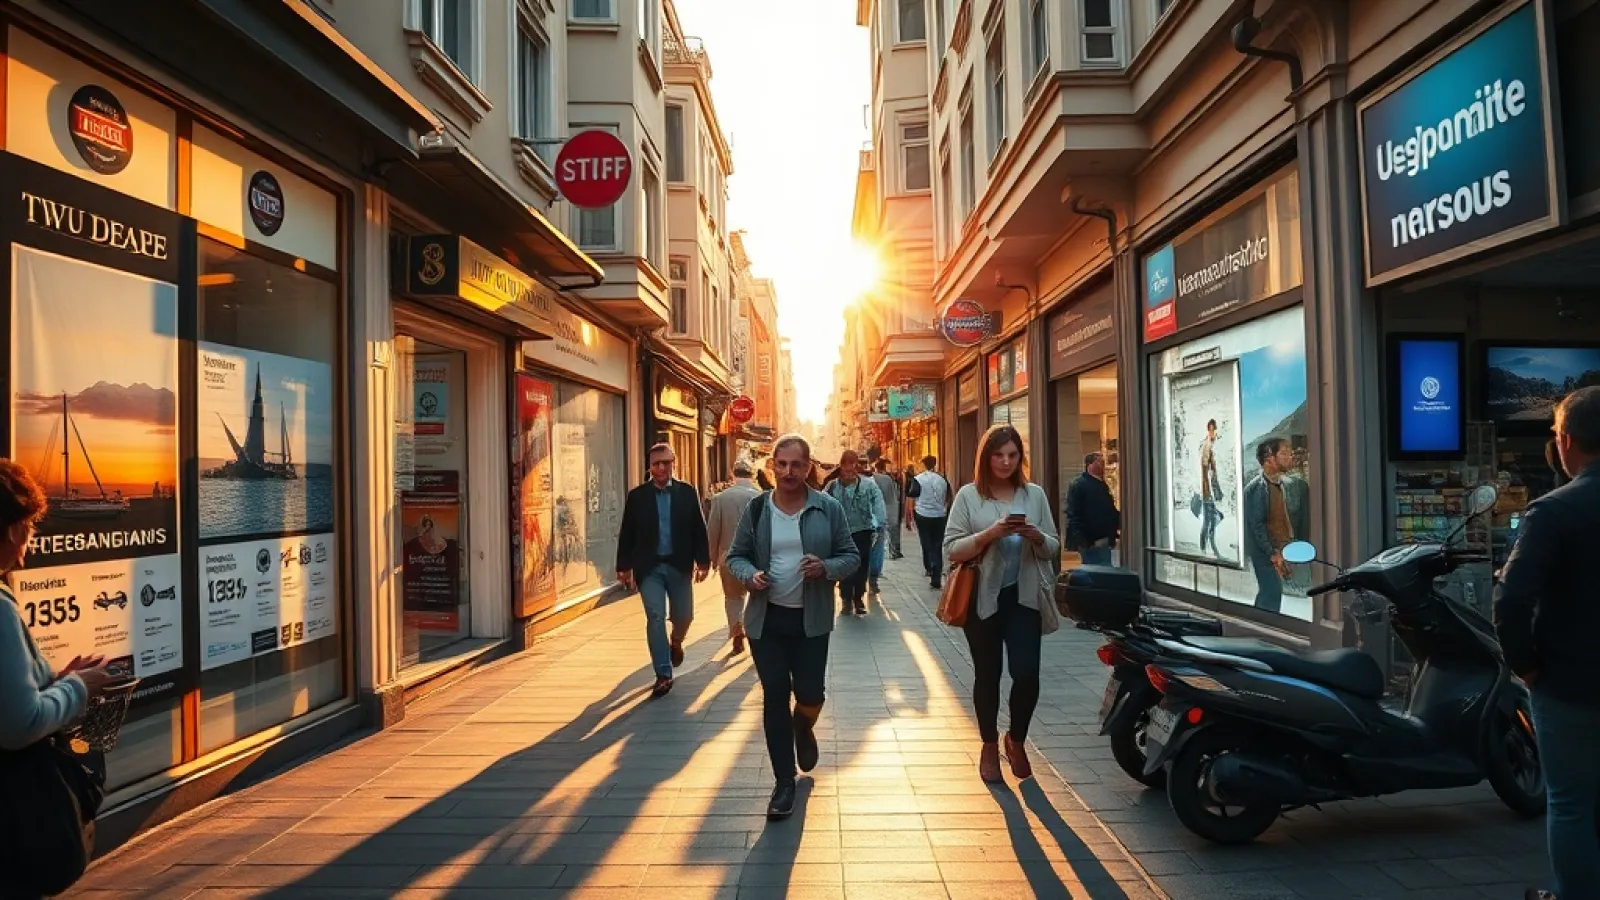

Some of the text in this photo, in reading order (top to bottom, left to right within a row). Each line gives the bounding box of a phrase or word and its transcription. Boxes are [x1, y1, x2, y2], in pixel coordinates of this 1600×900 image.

[562, 156, 627, 182] STIFF
[21, 191, 168, 260] TWU DEAPE
